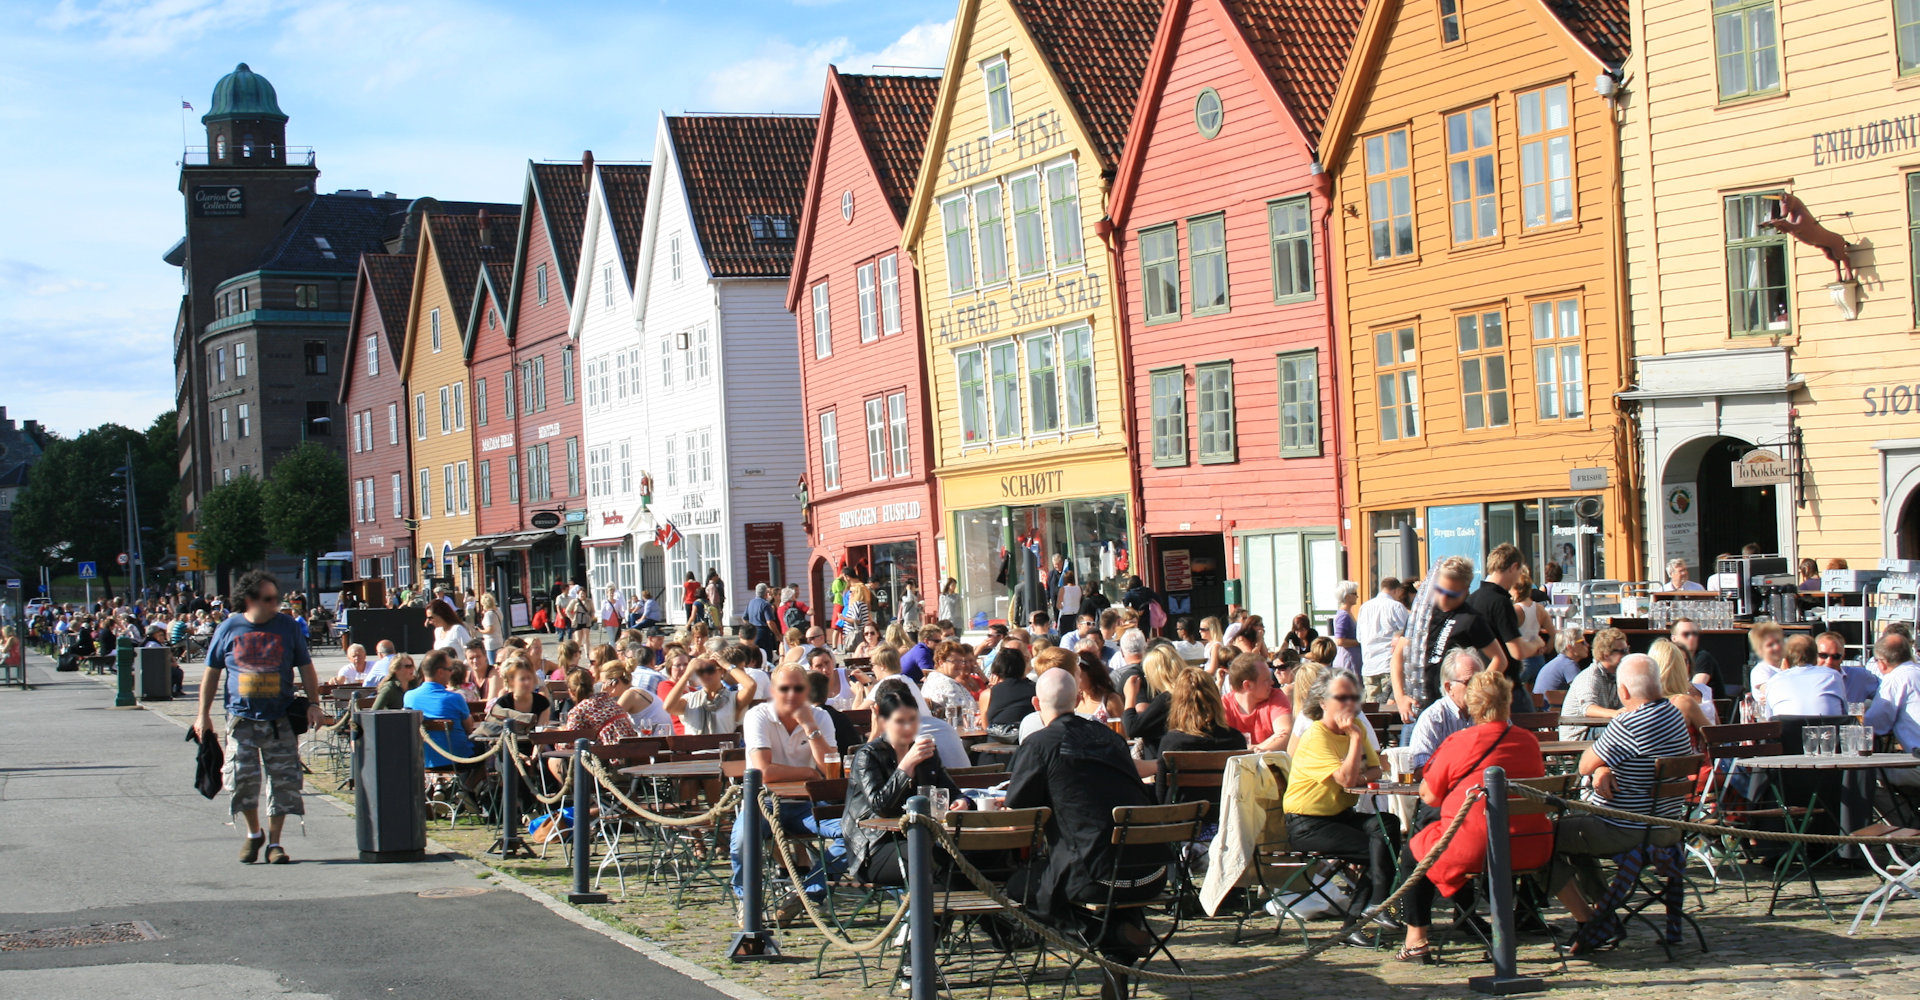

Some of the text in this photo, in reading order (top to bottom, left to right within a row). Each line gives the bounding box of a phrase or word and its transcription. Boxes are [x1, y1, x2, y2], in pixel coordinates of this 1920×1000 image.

[946, 135, 993, 185] SILD
[1014, 107, 1067, 160] FISK
[1812, 112, 1920, 167] ENHJØRNI
[939, 272, 1101, 345] ALFRED SKULSTAD
[1000, 469, 1064, 498] SCHJØTT
[839, 500, 922, 529] BRYGGEN HUSFLID
